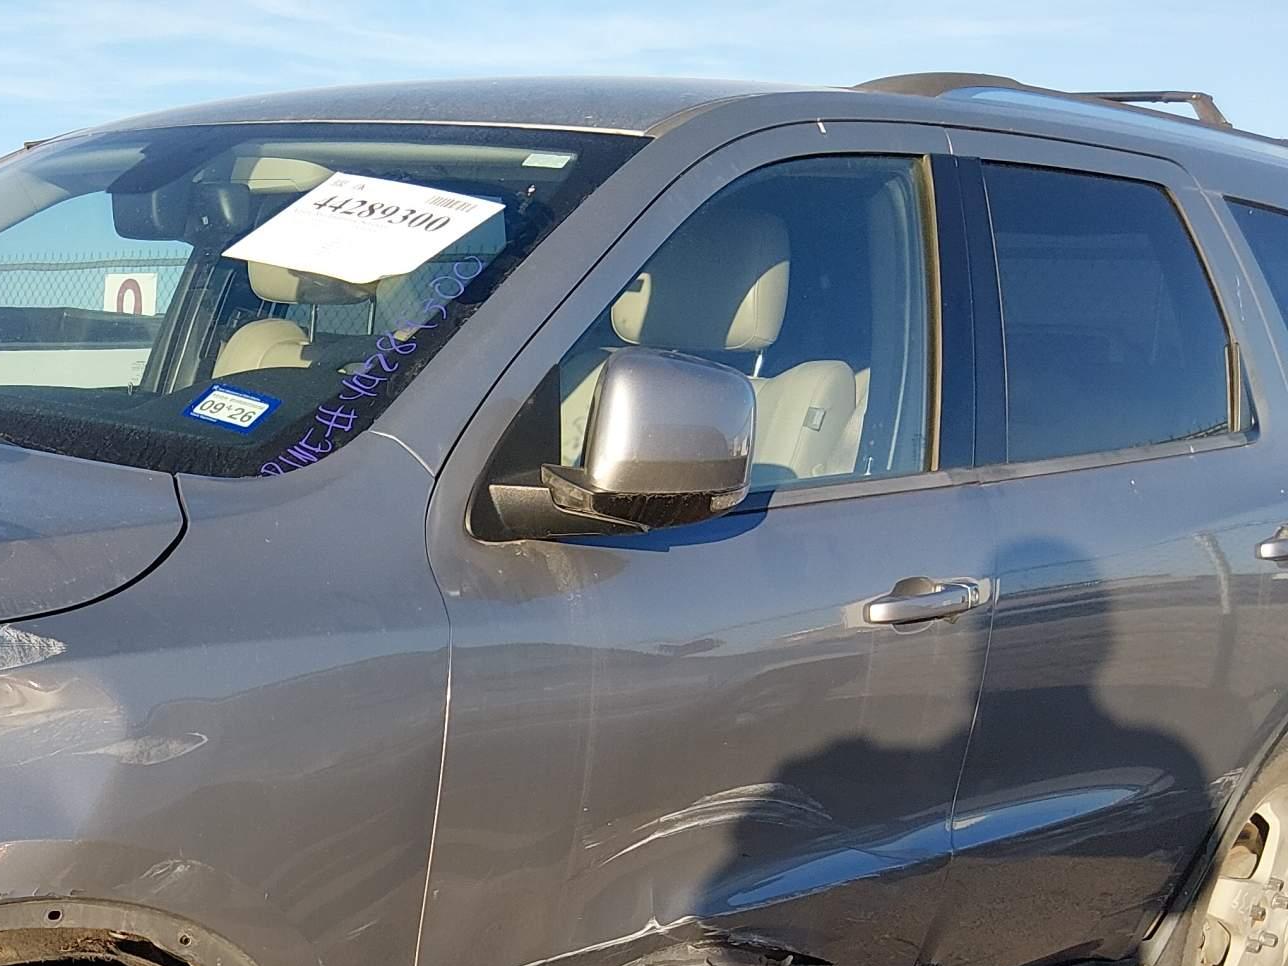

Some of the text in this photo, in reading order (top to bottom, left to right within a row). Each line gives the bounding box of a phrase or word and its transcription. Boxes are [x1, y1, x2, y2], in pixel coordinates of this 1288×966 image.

[312, 195, 451, 233] 44289300
[199, 399, 225, 414] 09
[227, 407, 256, 423] 26
